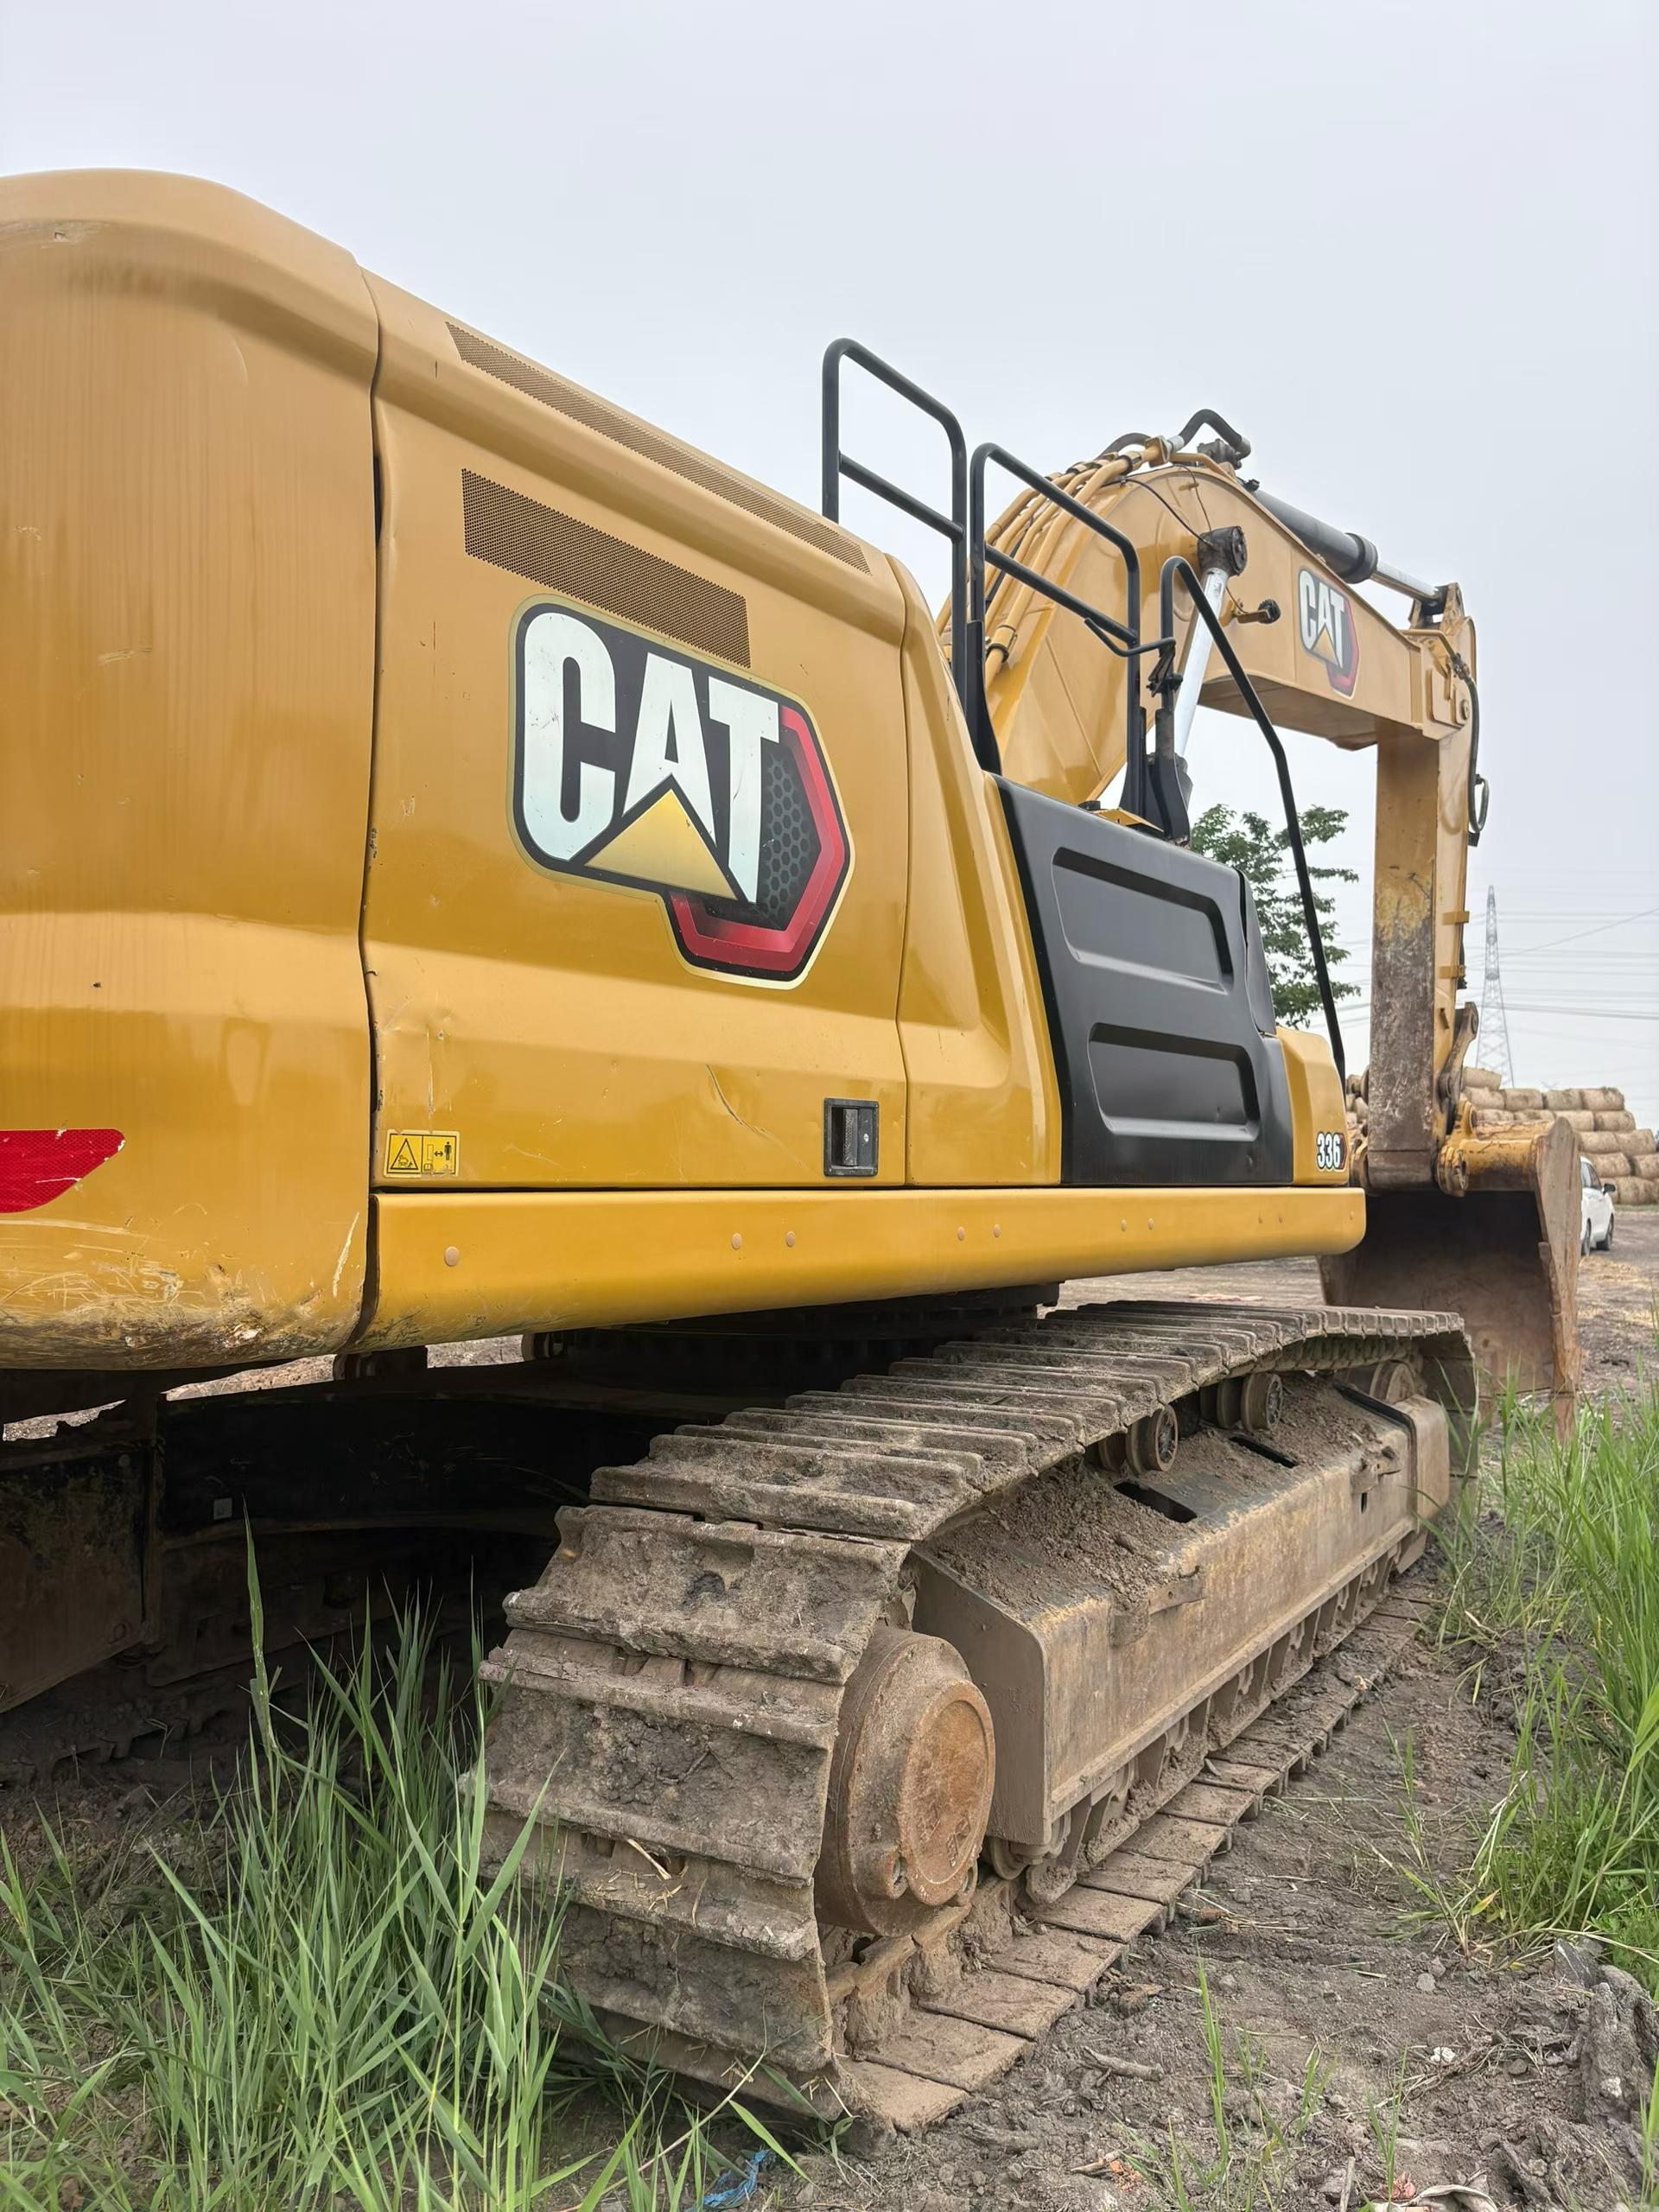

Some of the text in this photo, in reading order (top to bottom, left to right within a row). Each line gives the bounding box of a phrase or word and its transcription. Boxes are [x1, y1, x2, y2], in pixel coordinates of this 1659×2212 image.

[1300, 570, 1344, 669] CAT
[523, 612, 780, 905] CAT
[1317, 1133, 1341, 1168] 336
